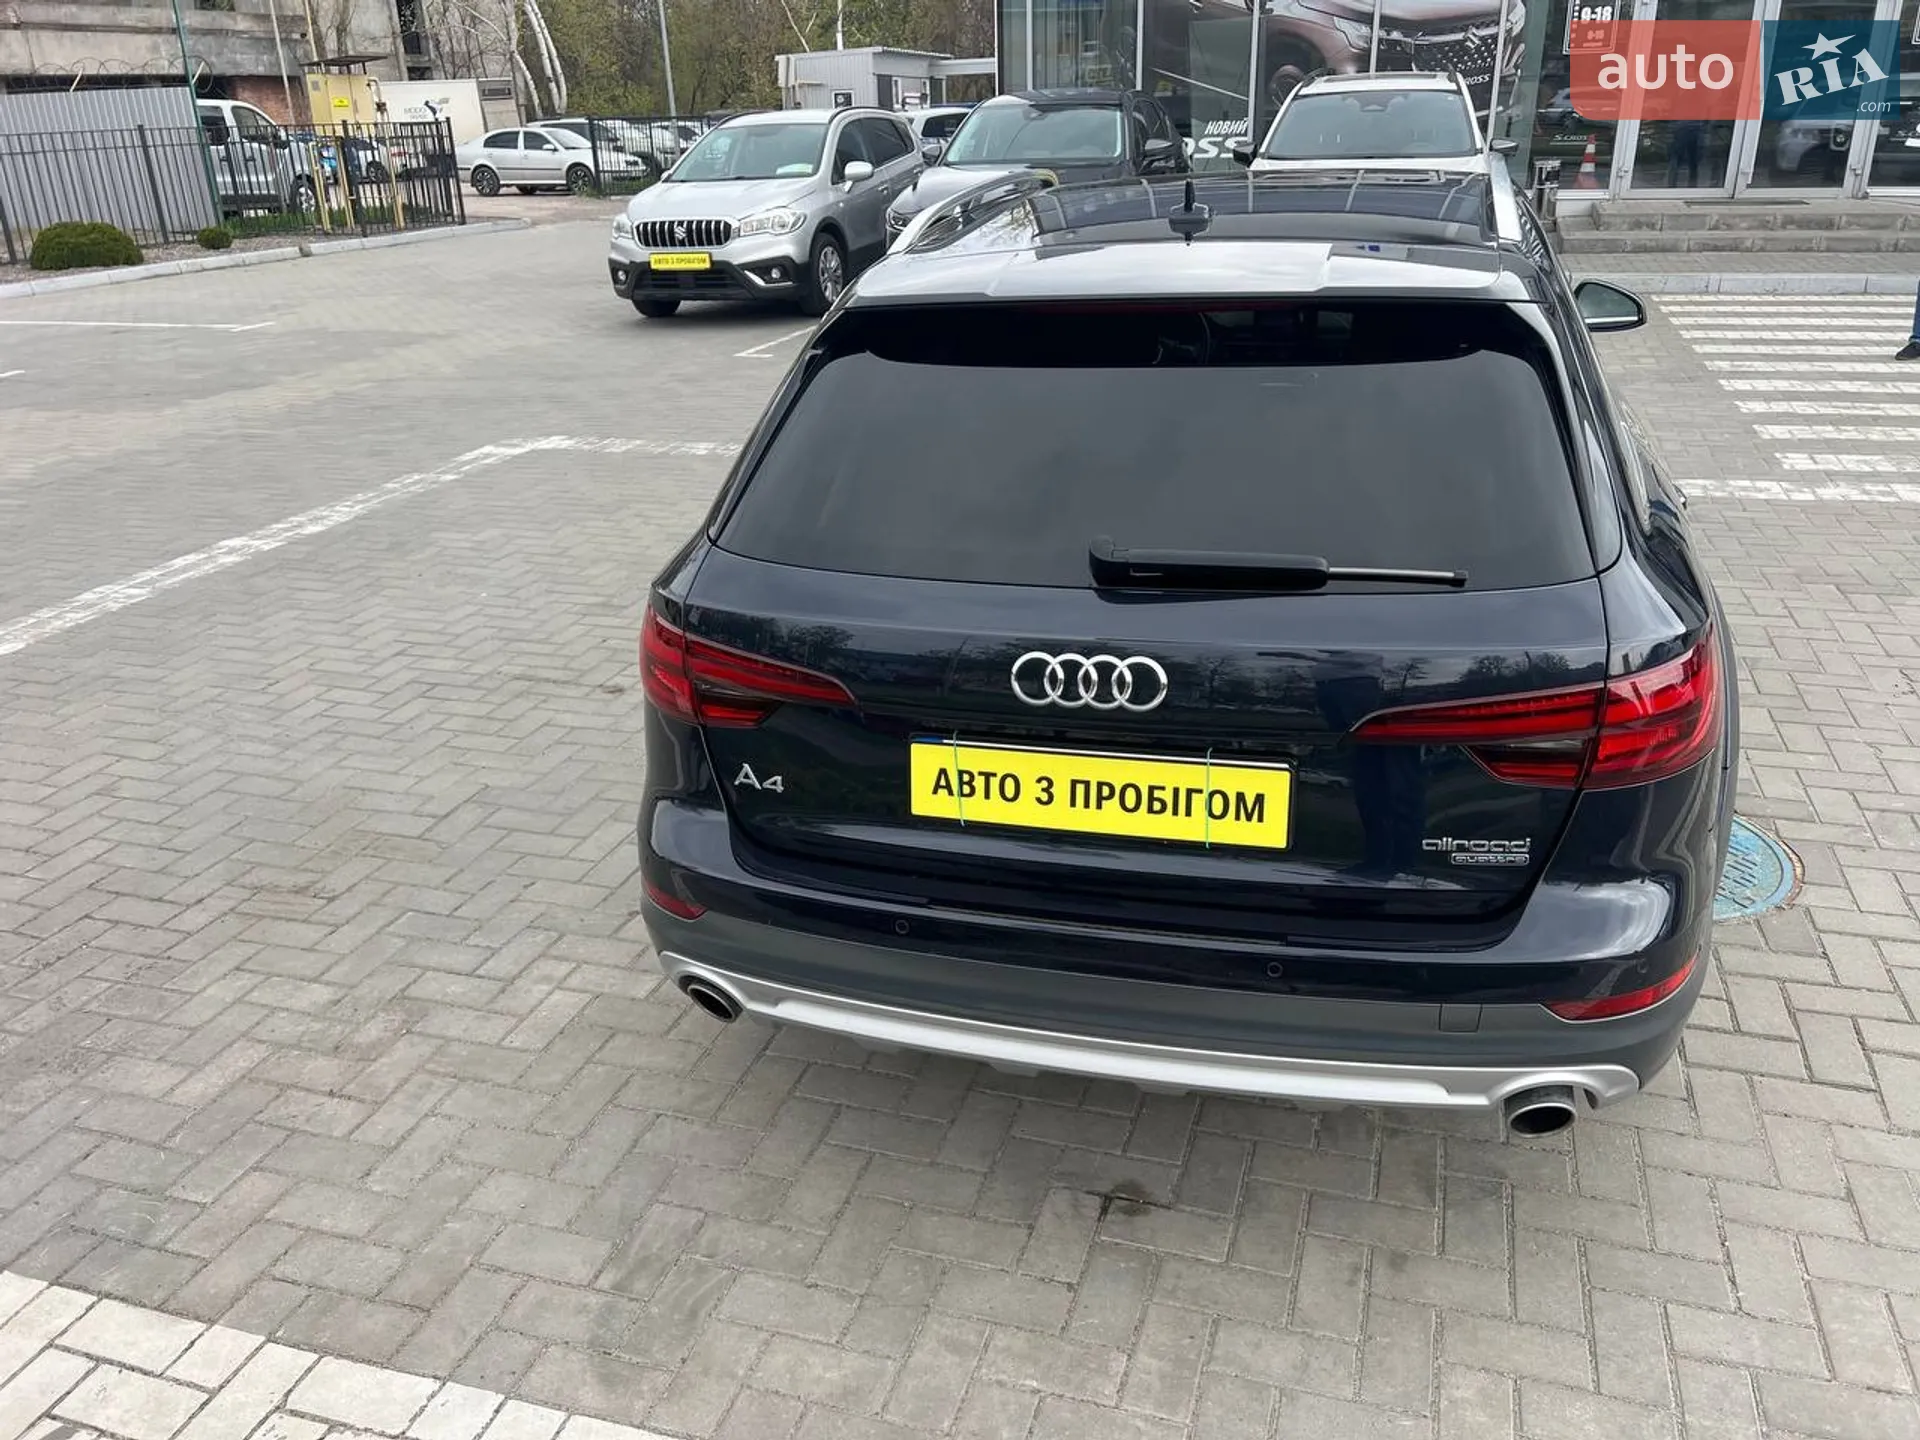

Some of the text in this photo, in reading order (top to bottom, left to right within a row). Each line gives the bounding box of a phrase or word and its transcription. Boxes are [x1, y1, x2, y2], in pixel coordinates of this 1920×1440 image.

[1204, 117, 1248, 135] НОВИЙ
[734, 762, 784, 793] A4
[932, 767, 1022, 803] АВТО
[1069, 778, 1266, 823] ПРОБІГОМ
[1422, 837, 1531, 852] allroad
[1454, 855, 1527, 864] quattro
